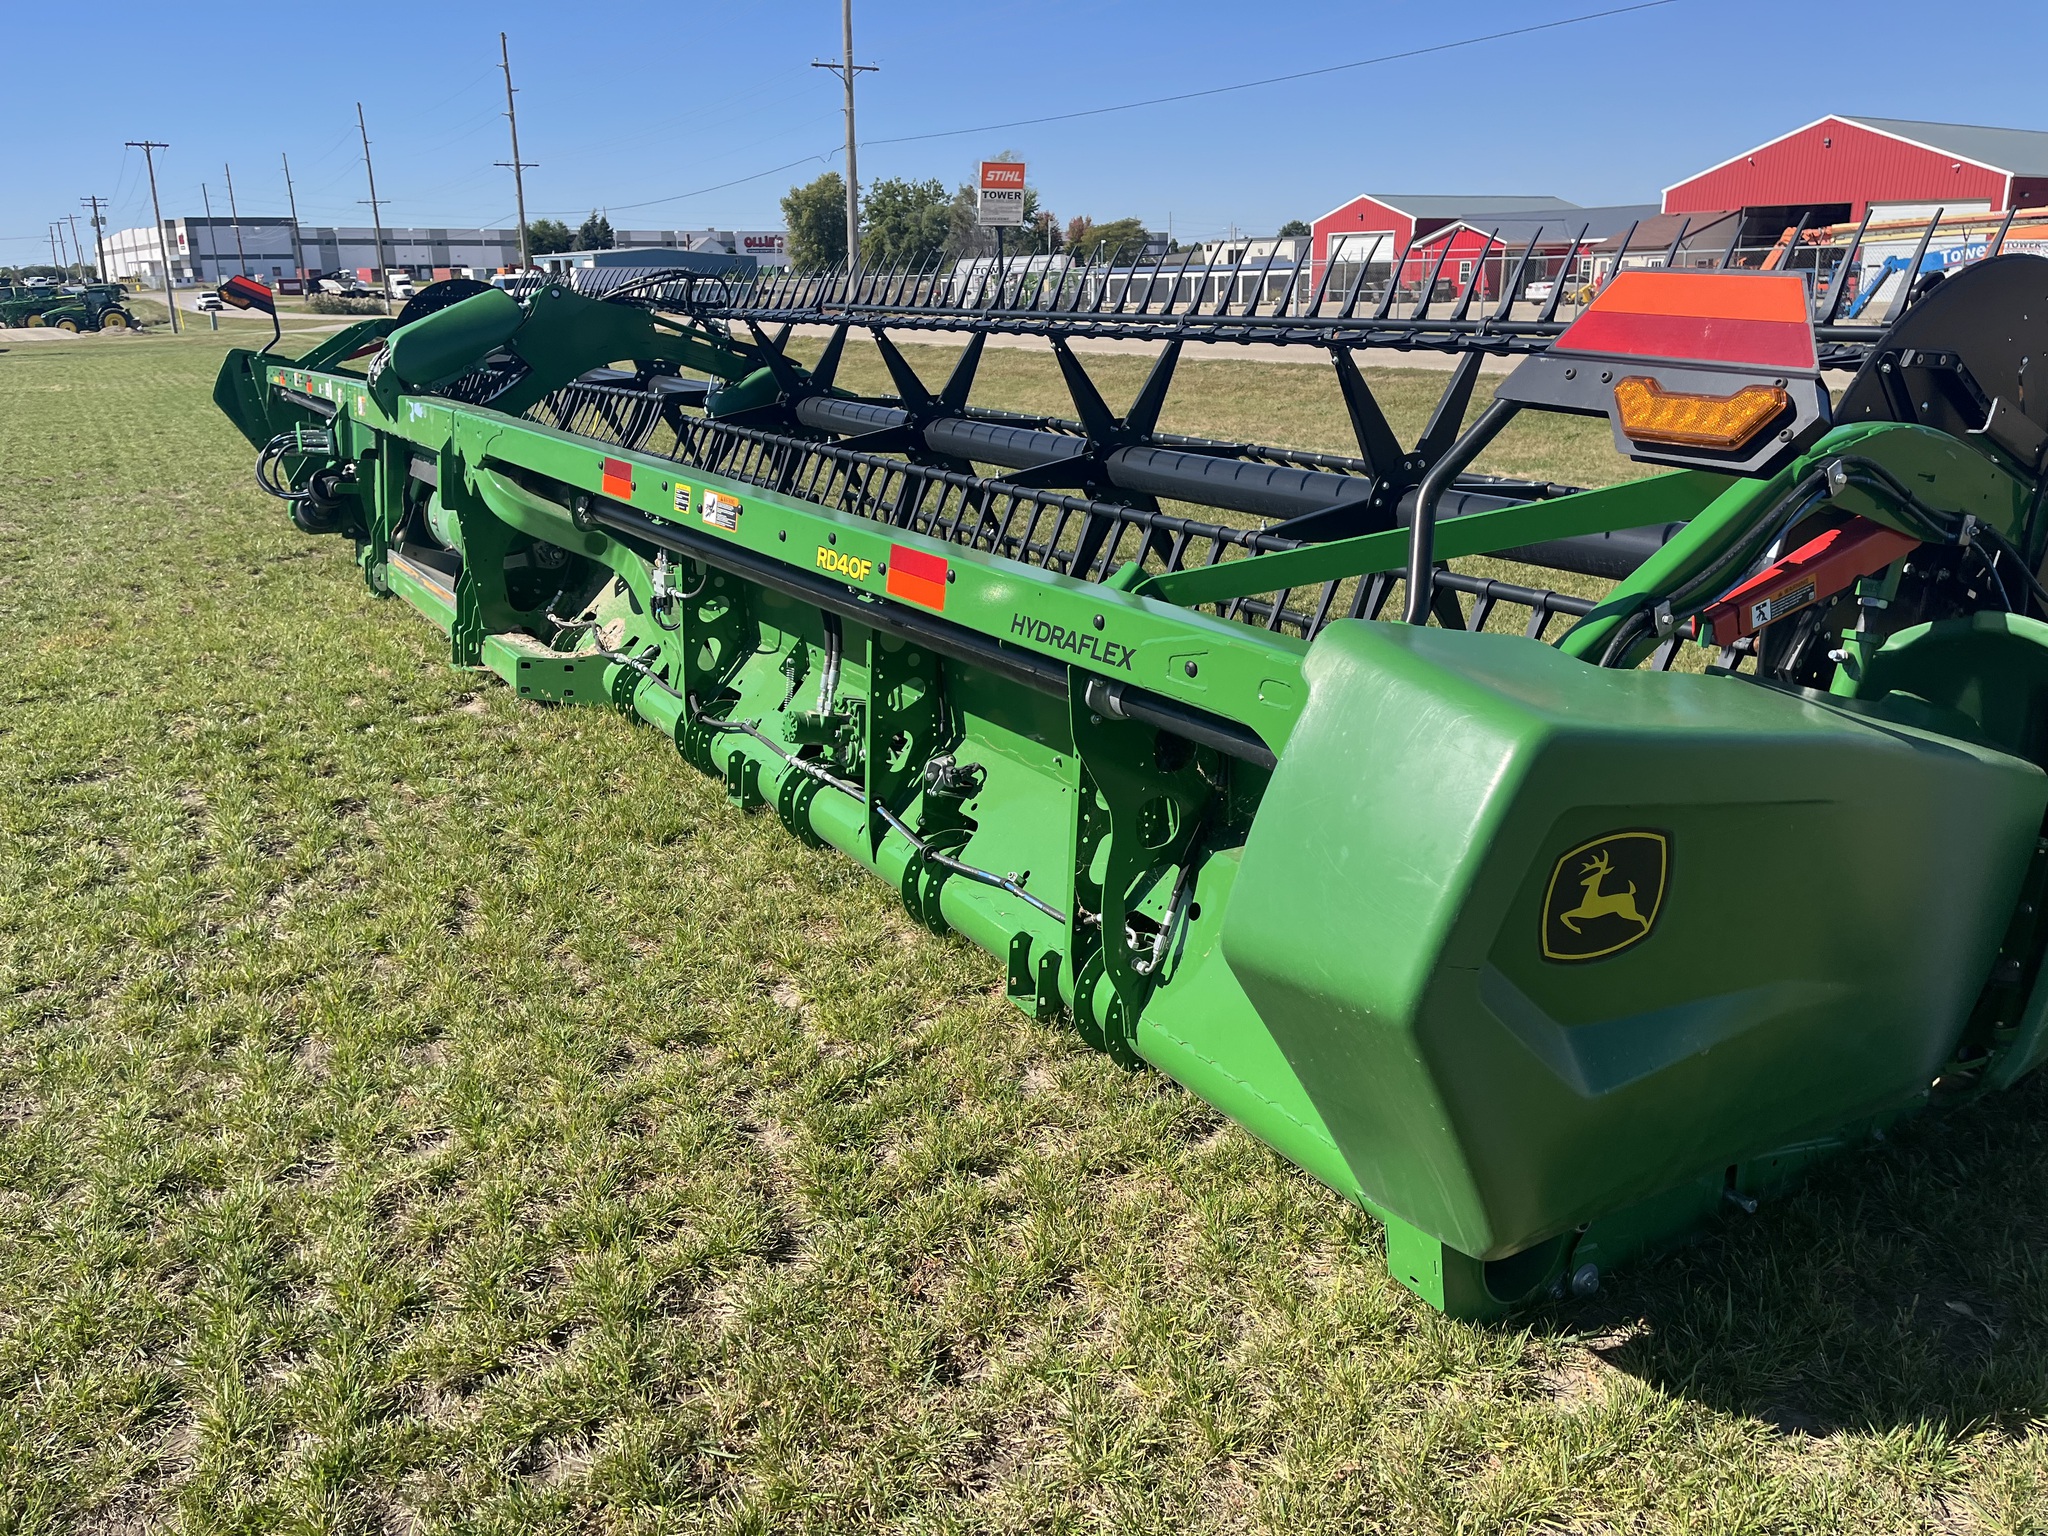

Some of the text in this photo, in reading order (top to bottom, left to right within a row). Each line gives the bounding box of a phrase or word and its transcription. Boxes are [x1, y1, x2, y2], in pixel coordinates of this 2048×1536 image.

[985, 170, 1022, 182] STIHL
[982, 190, 1022, 200] TOWER
[816, 545, 872, 582] RD40F
[1010, 613, 1137, 671] HYDRAFLEX
